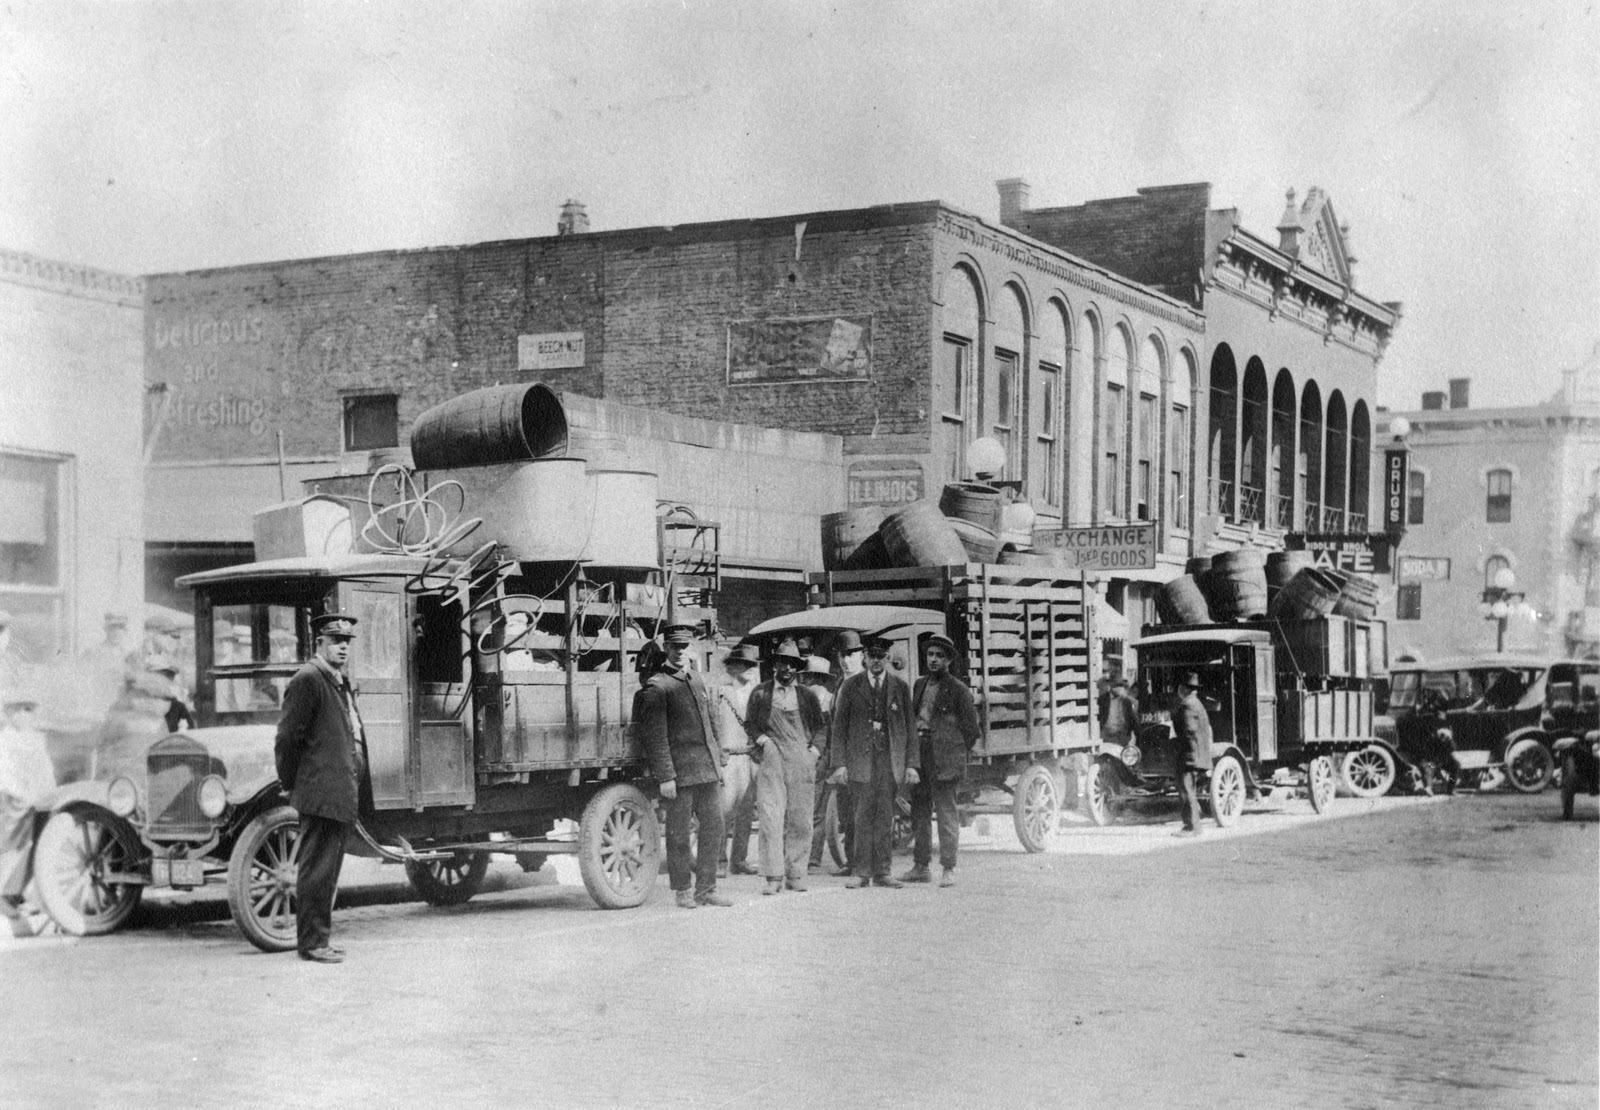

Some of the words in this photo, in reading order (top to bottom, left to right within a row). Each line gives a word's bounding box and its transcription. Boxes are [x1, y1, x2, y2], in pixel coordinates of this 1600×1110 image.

[155, 316, 262, 349] Delicious
[184, 360, 218, 382] and
[849, 480, 919, 502] ILLINOIS
[1390, 456, 1400, 522] DRUGS
[1101, 550, 1147, 567] GOODS
[1313, 549, 1375, 571] AFE
